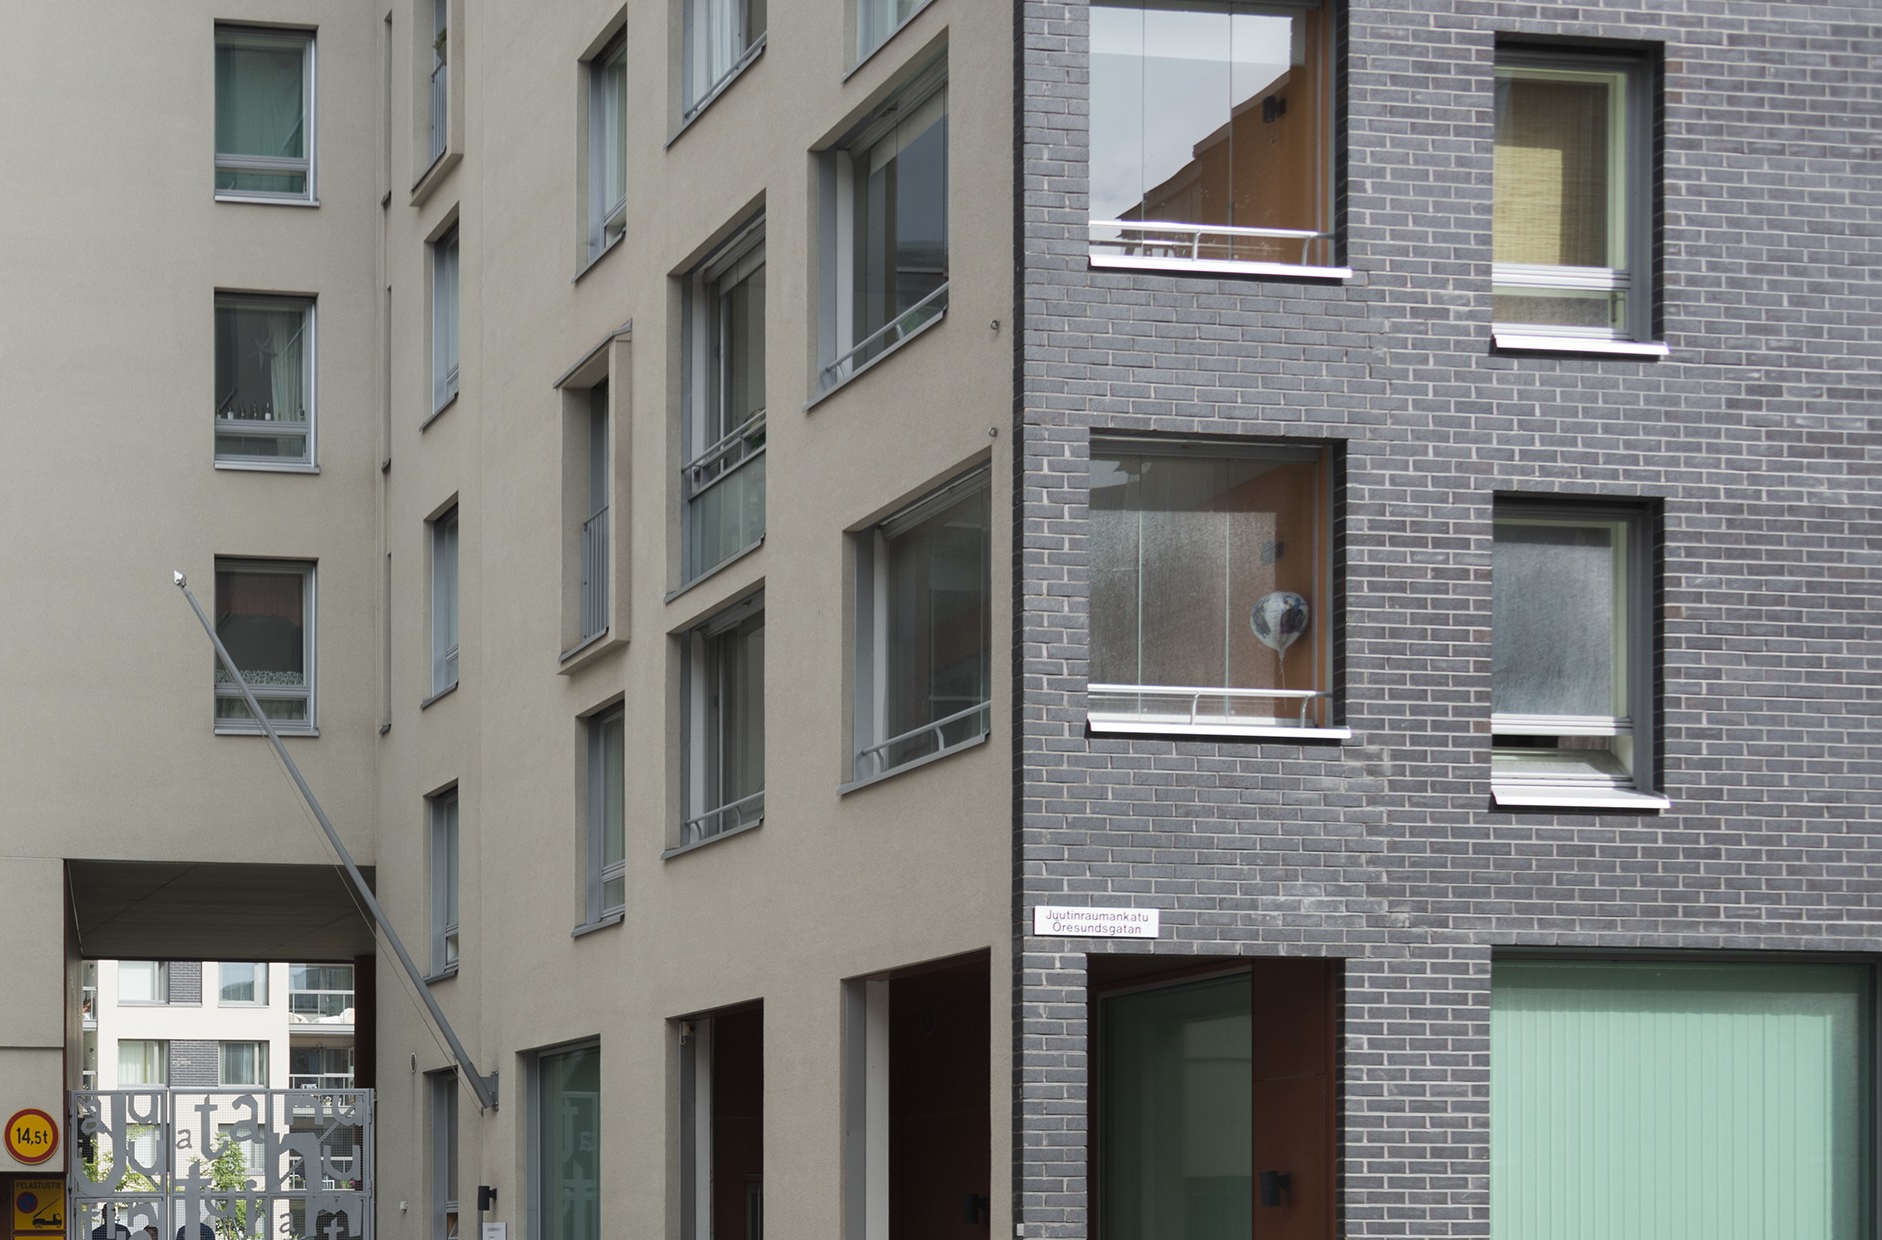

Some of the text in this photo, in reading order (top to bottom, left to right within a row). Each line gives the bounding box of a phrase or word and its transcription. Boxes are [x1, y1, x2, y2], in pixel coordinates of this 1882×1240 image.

[1045, 909, 1149, 923] Juutinraumankatu
[1052, 919, 1142, 935] Öresundsgatan
[15, 1181, 62, 1190] PELASTUSTIE
